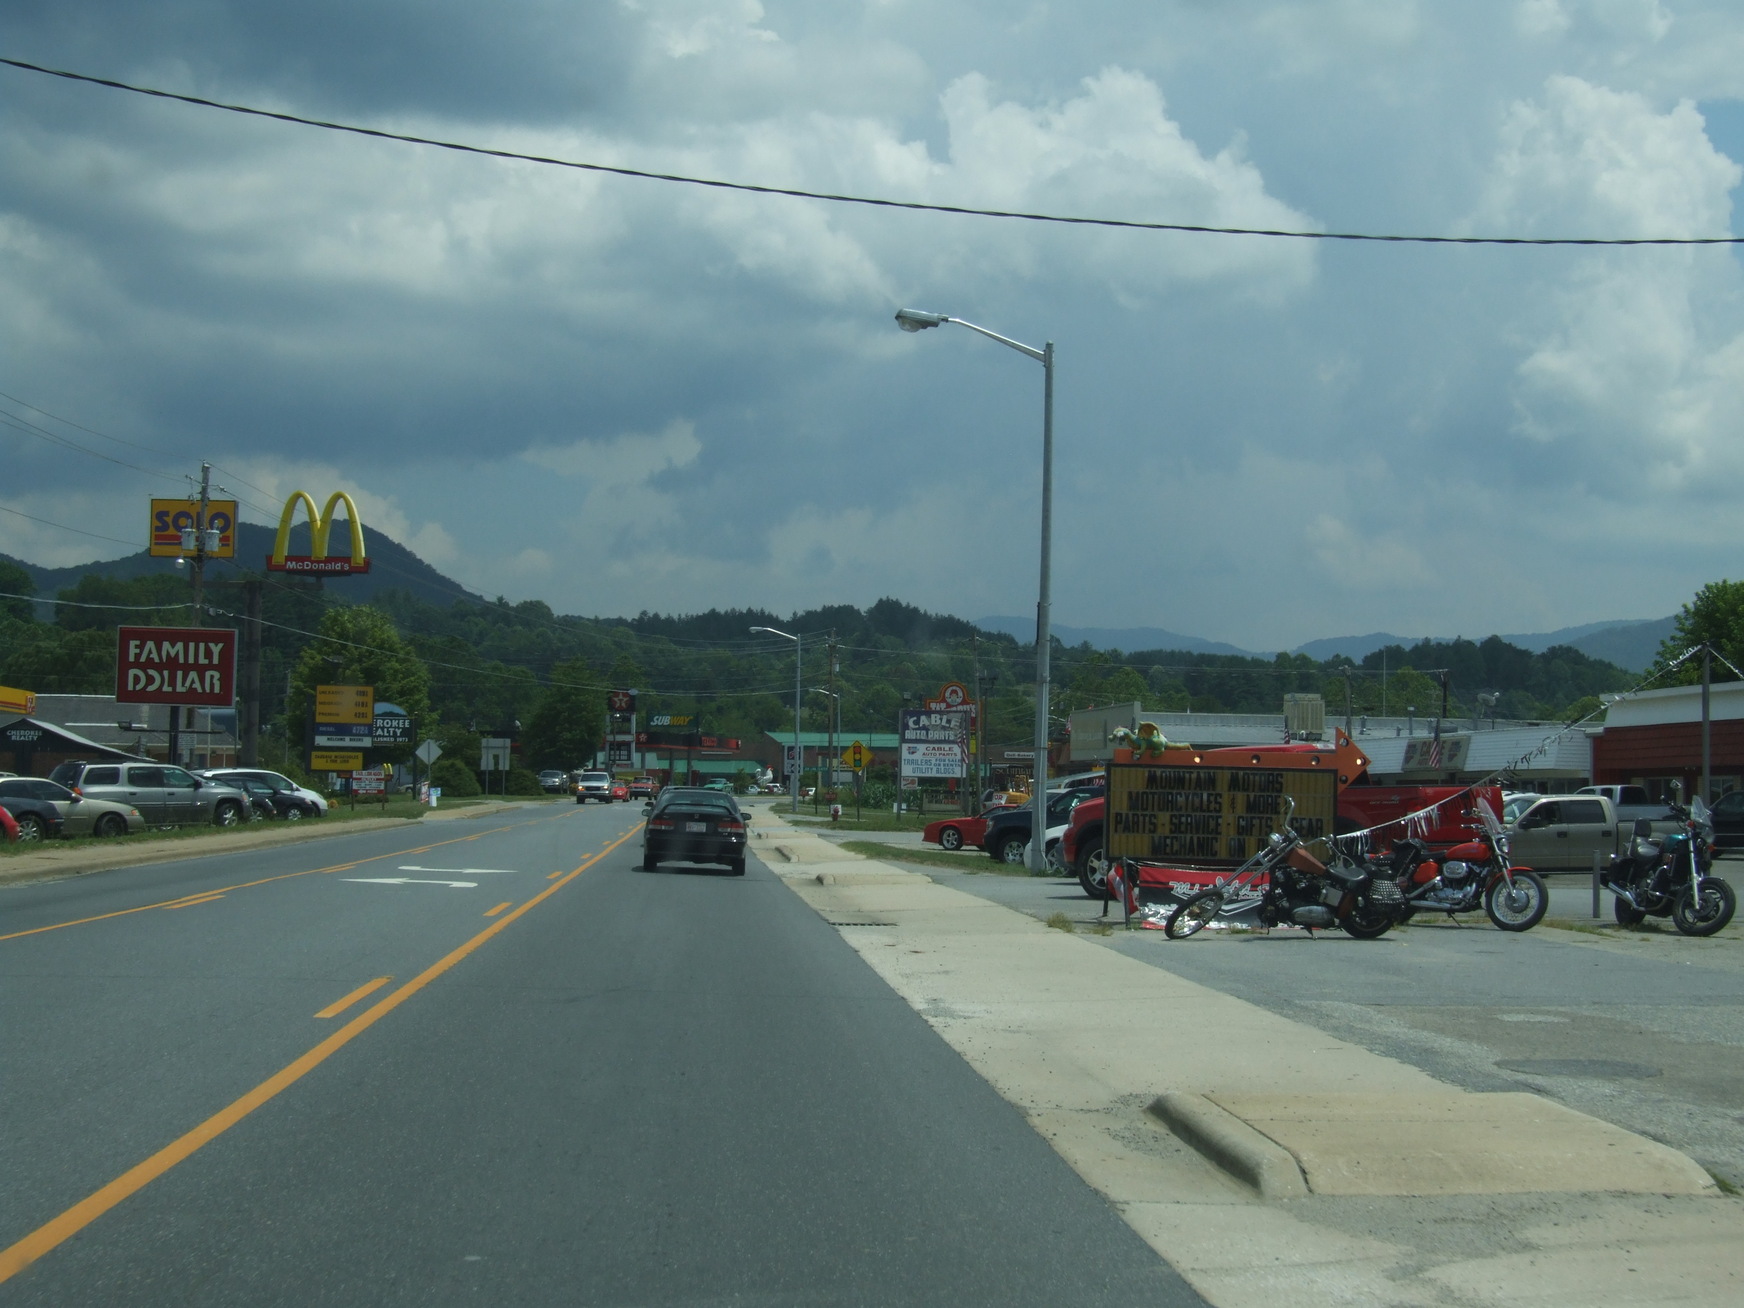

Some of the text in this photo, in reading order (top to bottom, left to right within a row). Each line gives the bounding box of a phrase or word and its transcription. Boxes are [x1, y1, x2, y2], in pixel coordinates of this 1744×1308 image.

[286, 561, 350, 571] McDonald's
[128, 640, 225, 665] FAMILY
[127, 668, 221, 694] DOLLAR
[373, 719, 410, 728] ROKEE
[650, 715, 691, 726] SUBWAY
[908, 713, 961, 729] CABLE
[373, 728, 403, 736] ALTY
[905, 730, 955, 740] AUTO PARTS
[903, 758, 933, 766] TRAILERS
[1146, 770, 1283, 793] MOUNTAIN MOTORS
[1127, 791, 1222, 813] MOTORCYCLES
[1246, 794, 1281, 815] MORE
[1114, 813, 1156, 833] PARTS
[1169, 814, 1222, 835] SERVICE
[1237, 816, 1274, 836] GIFTS
[1291, 817, 1324, 838] GEAR
[1151, 836, 1218, 857] MECHANIC
[1229, 838, 1246, 859] ON
